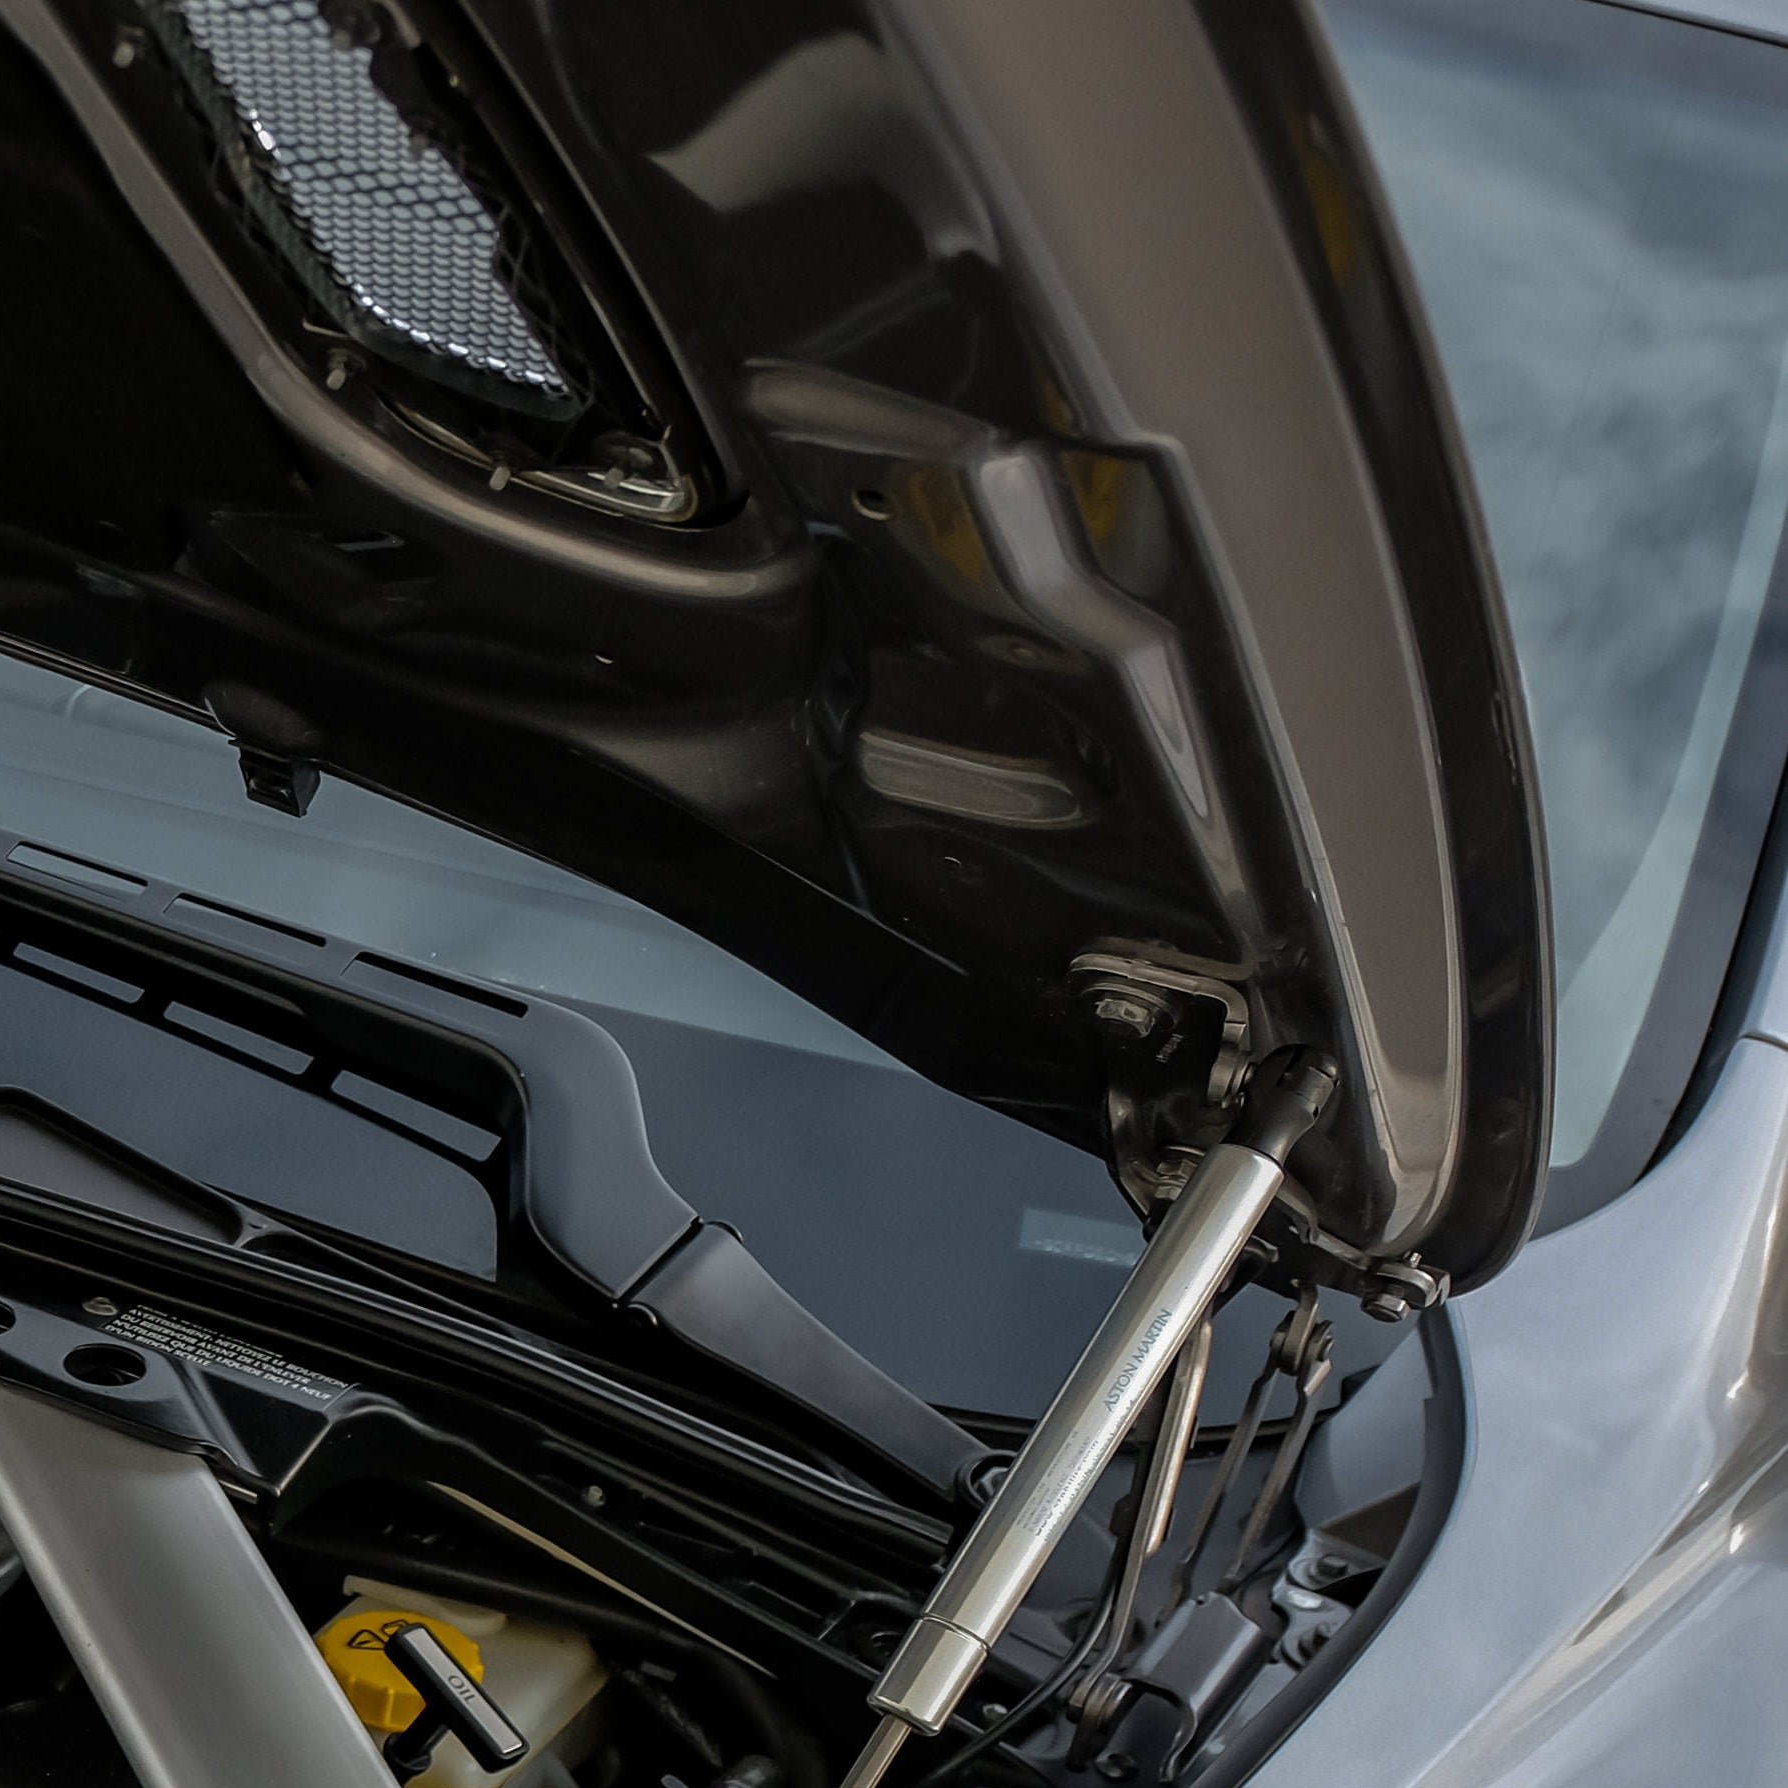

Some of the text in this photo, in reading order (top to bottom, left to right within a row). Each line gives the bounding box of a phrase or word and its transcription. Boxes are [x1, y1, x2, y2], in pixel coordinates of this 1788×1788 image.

[120, 1313, 141, 1324] DU
[196, 1341, 239, 1359] AVANT
[195, 1348, 217, 1359] DU
[262, 1372, 292, 1386] DOT
[1103, 1308, 1173, 1412] ASTON MARTIN
[448, 1675, 476, 1705] OIL
